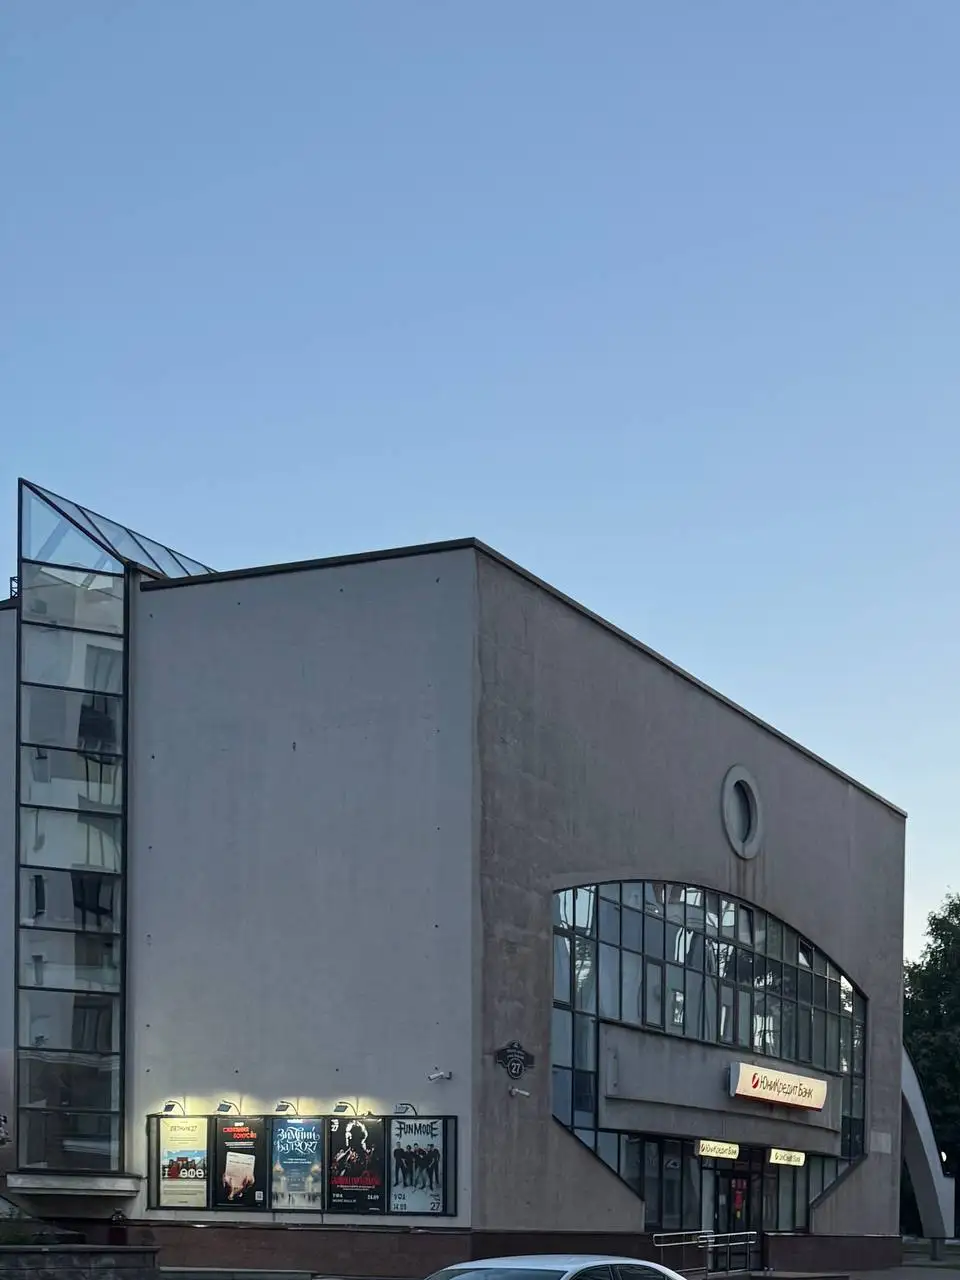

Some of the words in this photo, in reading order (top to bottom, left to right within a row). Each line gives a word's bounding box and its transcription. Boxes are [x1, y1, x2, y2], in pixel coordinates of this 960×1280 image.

[511, 1062, 521, 1074] 27
[759, 1073, 798, 1097] ЮниКредит
[798, 1082, 814, 1100] Банк
